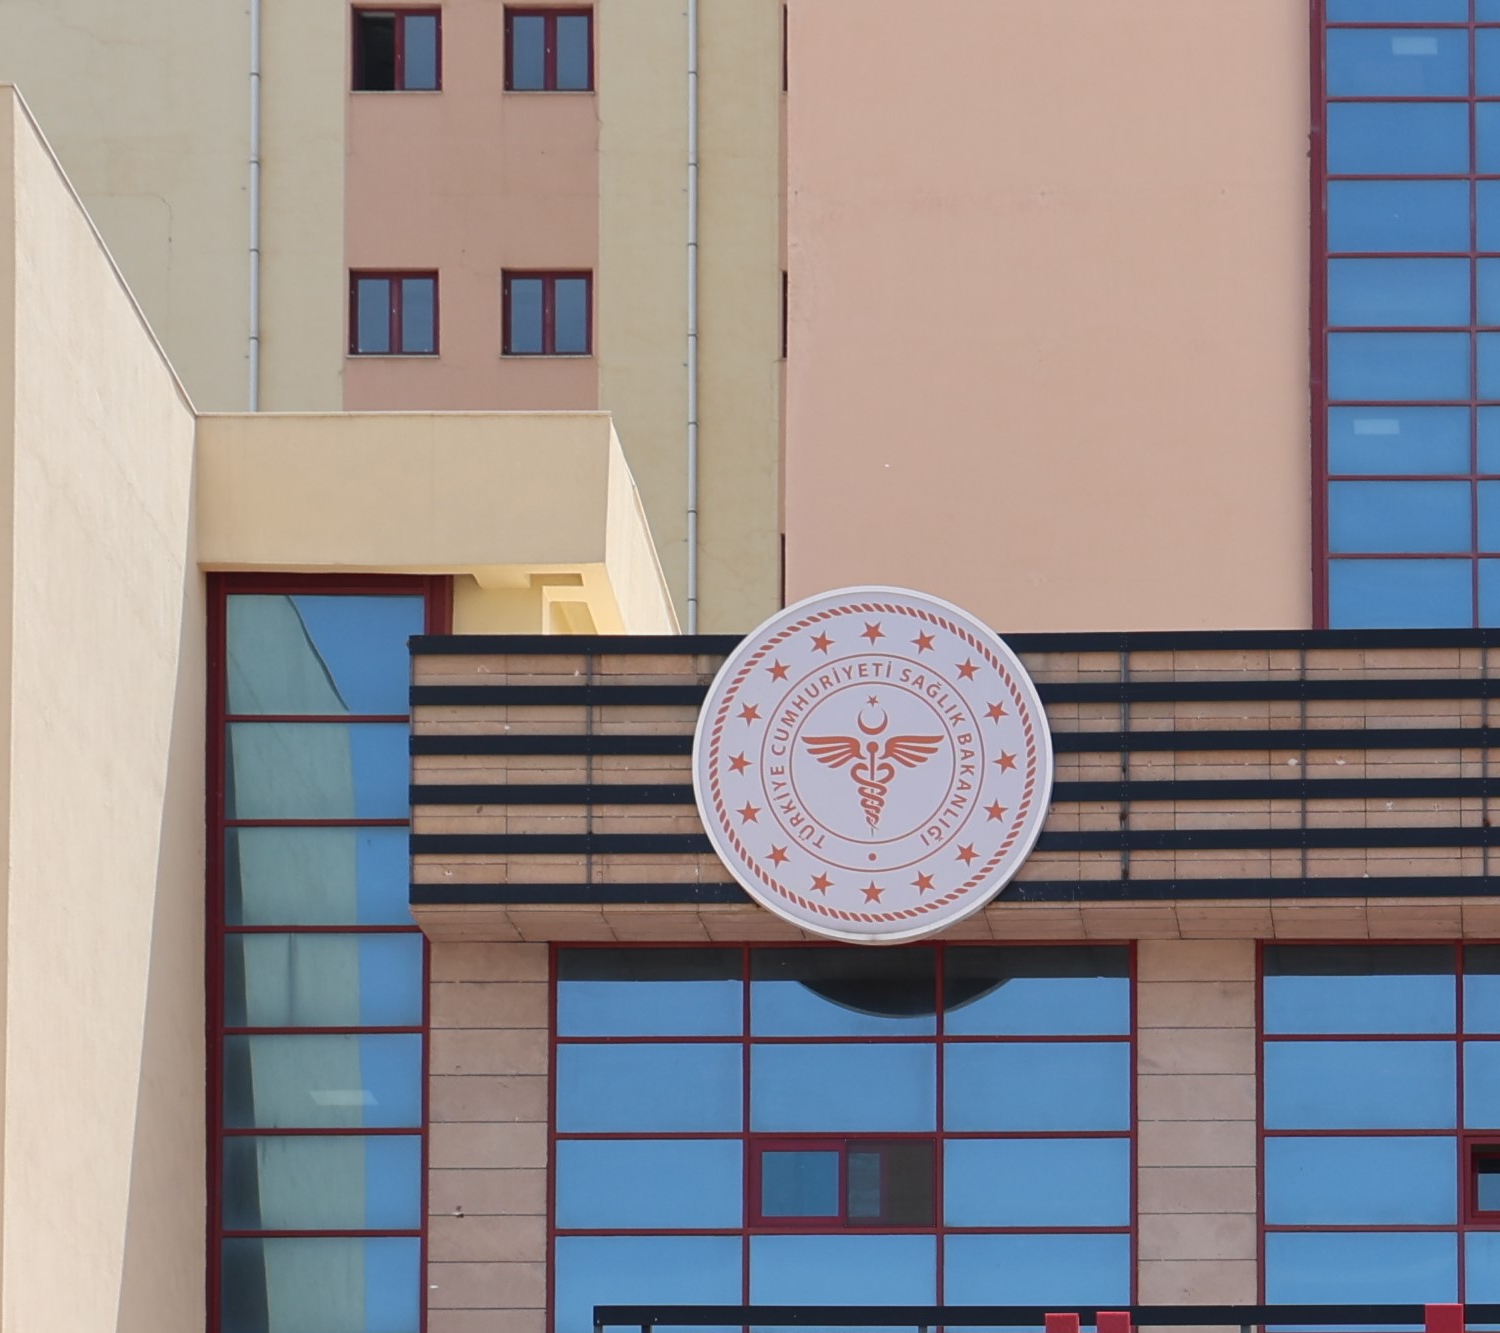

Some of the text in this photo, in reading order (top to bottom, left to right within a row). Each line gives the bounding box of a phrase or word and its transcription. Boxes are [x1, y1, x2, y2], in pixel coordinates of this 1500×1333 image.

[769, 661, 975, 851] TÜRKİYE CUMHURİYETİ SAĞLIK BAKANLIĞI
